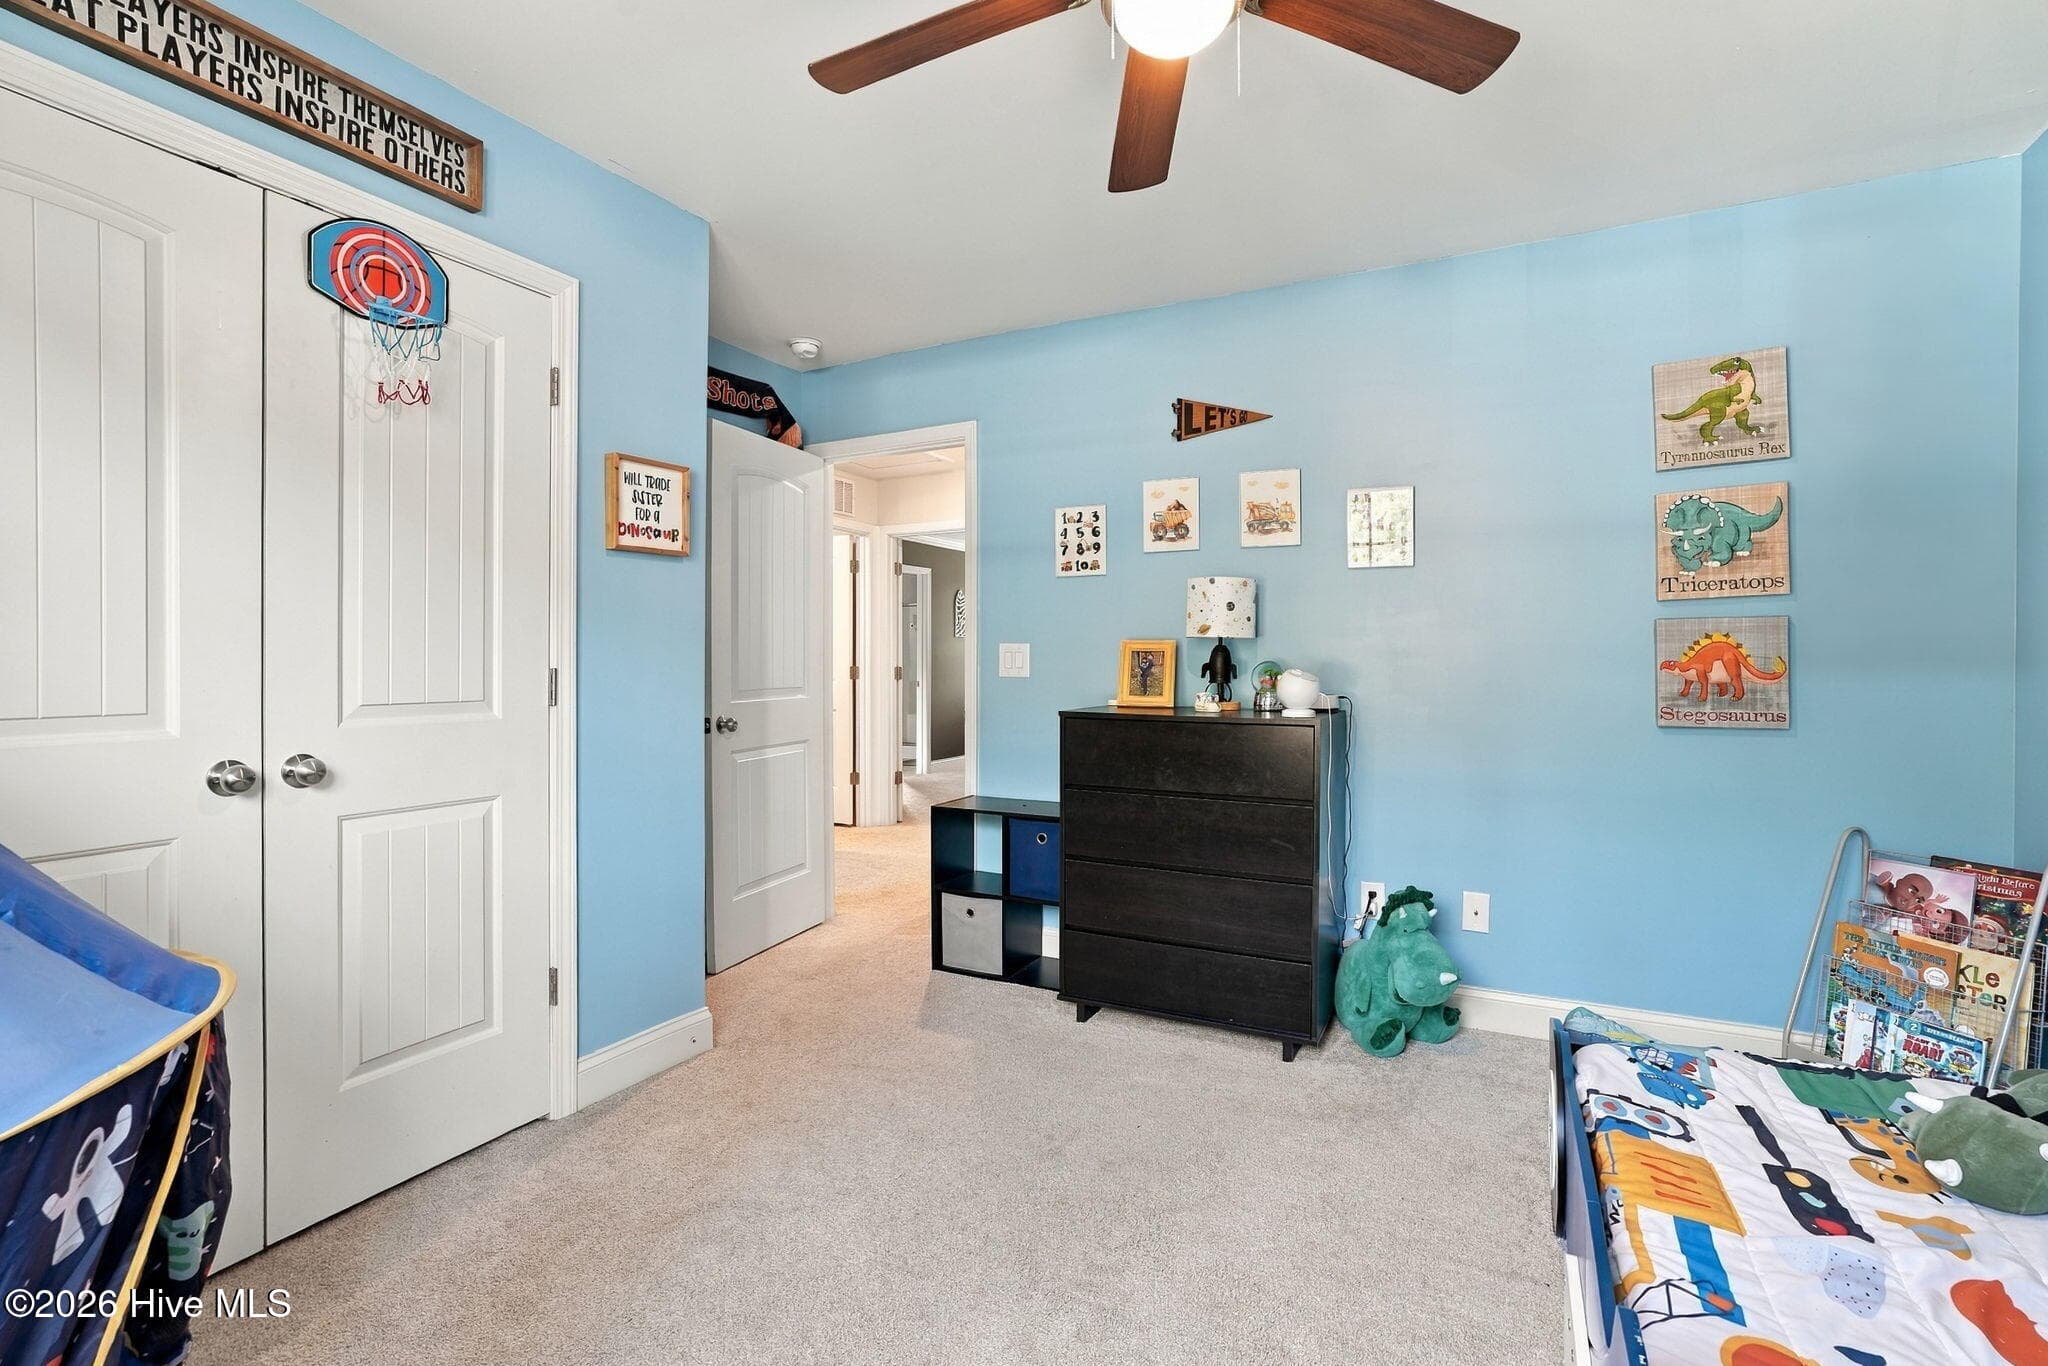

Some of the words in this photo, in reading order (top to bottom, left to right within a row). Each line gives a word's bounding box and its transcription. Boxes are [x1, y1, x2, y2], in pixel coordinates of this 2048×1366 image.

[109, 0, 223, 54] AYERS
[235, 34, 327, 102] INSPIRE
[338, 87, 465, 167] THEMSELVES
[117, 11, 263, 104] PLAYERS
[275, 87, 374, 154] INSPIRE
[384, 137, 466, 194] OTHERS
[707, 376, 778, 411] Shots
[1184, 402, 1237, 435] LET'S
[1661, 446, 1754, 466] Tyrannosaurus
[1758, 442, 1785, 455] Rex
[624, 471, 642, 486] WILL
[645, 474, 671, 491] TRADE
[632, 489, 663, 507] SISTER
[635, 507, 651, 521] FOR
[1061, 512, 1067, 524] 1
[1076, 511, 1083, 523] 2
[1091, 511, 1099, 522] 3
[1060, 528, 1068, 539] 4
[1076, 527, 1084, 538] 5
[1091, 526, 1100, 537] 6
[1060, 544, 1068, 556] 7
[1076, 543, 1085, 555] 8
[1092, 542, 1101, 554] 9
[1076, 560, 1089, 571] 10
[1661, 575, 1785, 593] Triceratops
[1660, 706, 1787, 725] Stegosaurus
[1977, 884, 2023, 898] ristmas
[2002, 877, 2035, 889] Before
[1910, 1023, 1917, 1031] 2
